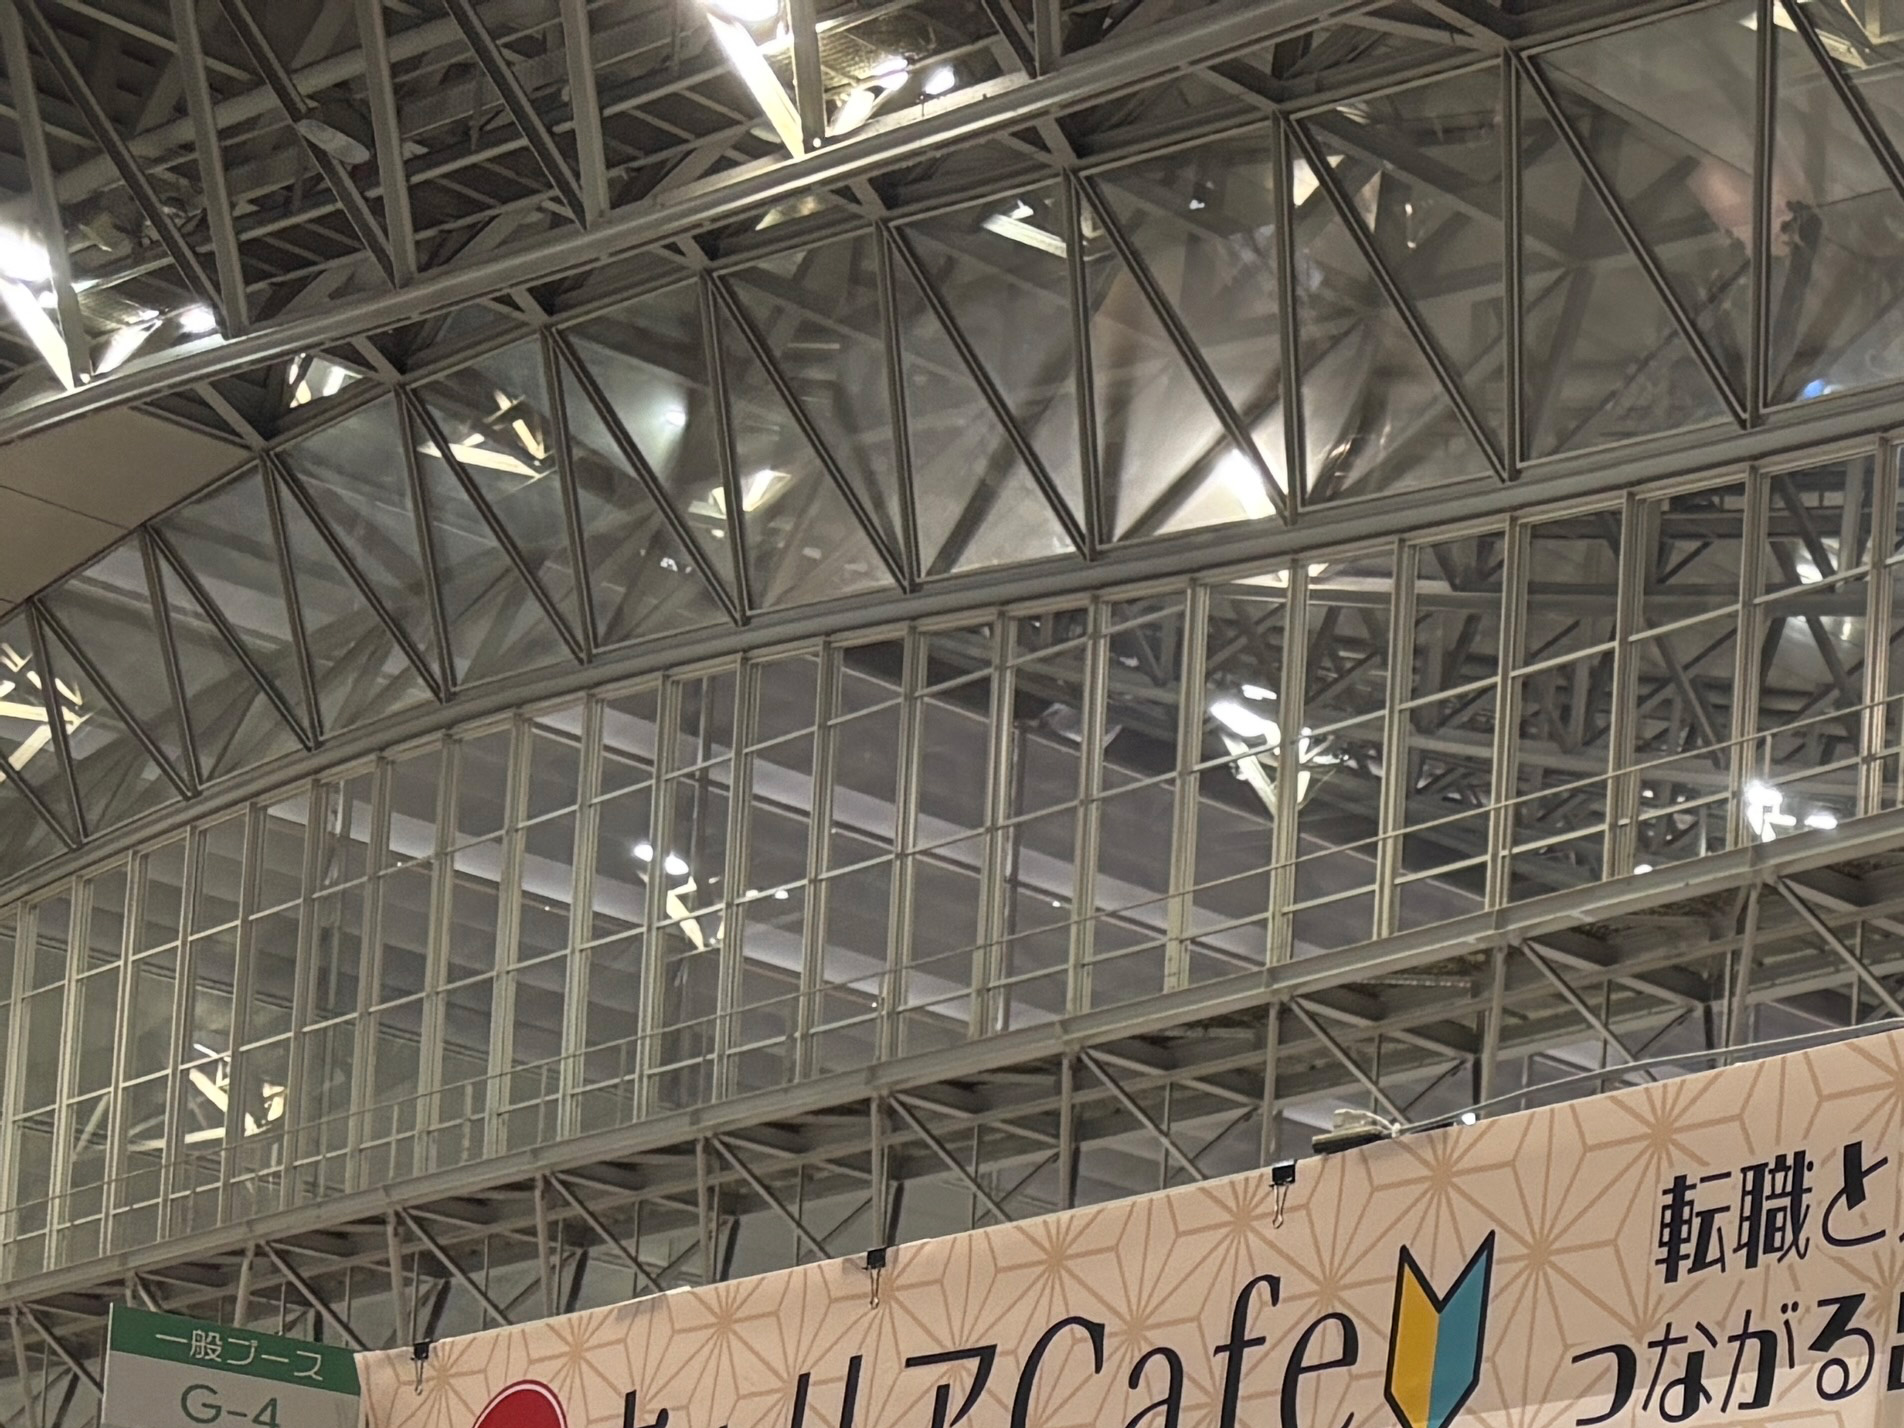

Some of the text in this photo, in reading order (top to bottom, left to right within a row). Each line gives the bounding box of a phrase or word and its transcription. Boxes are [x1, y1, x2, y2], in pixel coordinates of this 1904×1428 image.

[156, 1329, 323, 1381] 一般ブース
